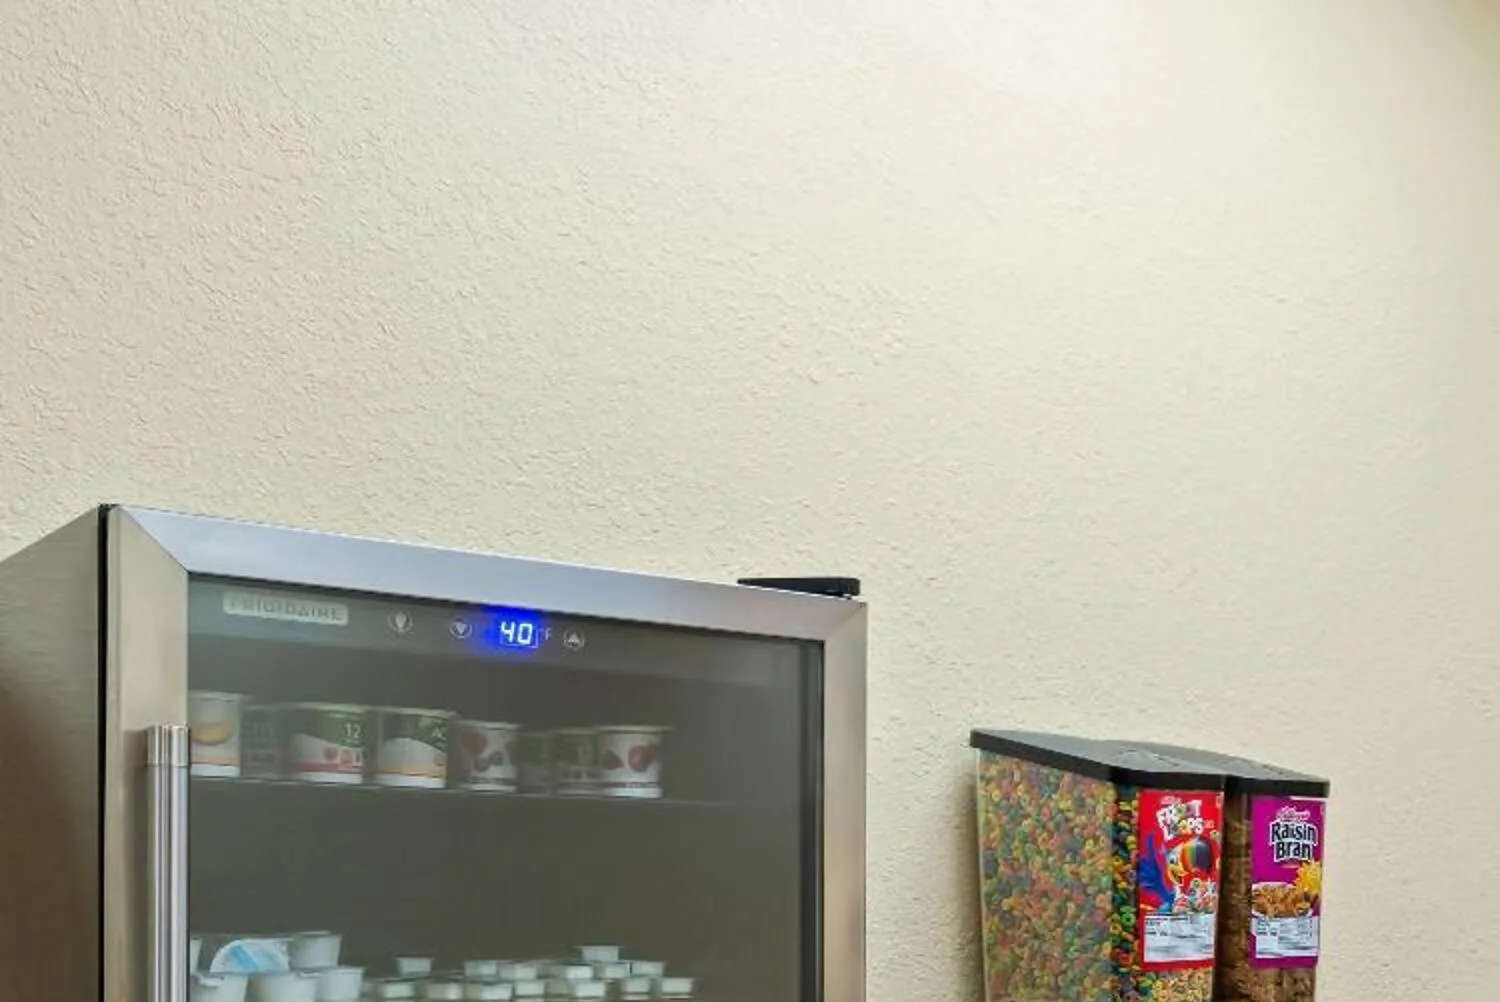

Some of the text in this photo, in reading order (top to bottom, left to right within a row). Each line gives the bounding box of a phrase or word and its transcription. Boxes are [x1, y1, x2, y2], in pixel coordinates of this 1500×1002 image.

[501, 621, 533, 645] 40
[1156, 799, 1203, 829] FROOT
[1162, 816, 1204, 842] LOOPS
[1270, 821, 1318, 845] Raisin
[1275, 841, 1312, 861] Bran
